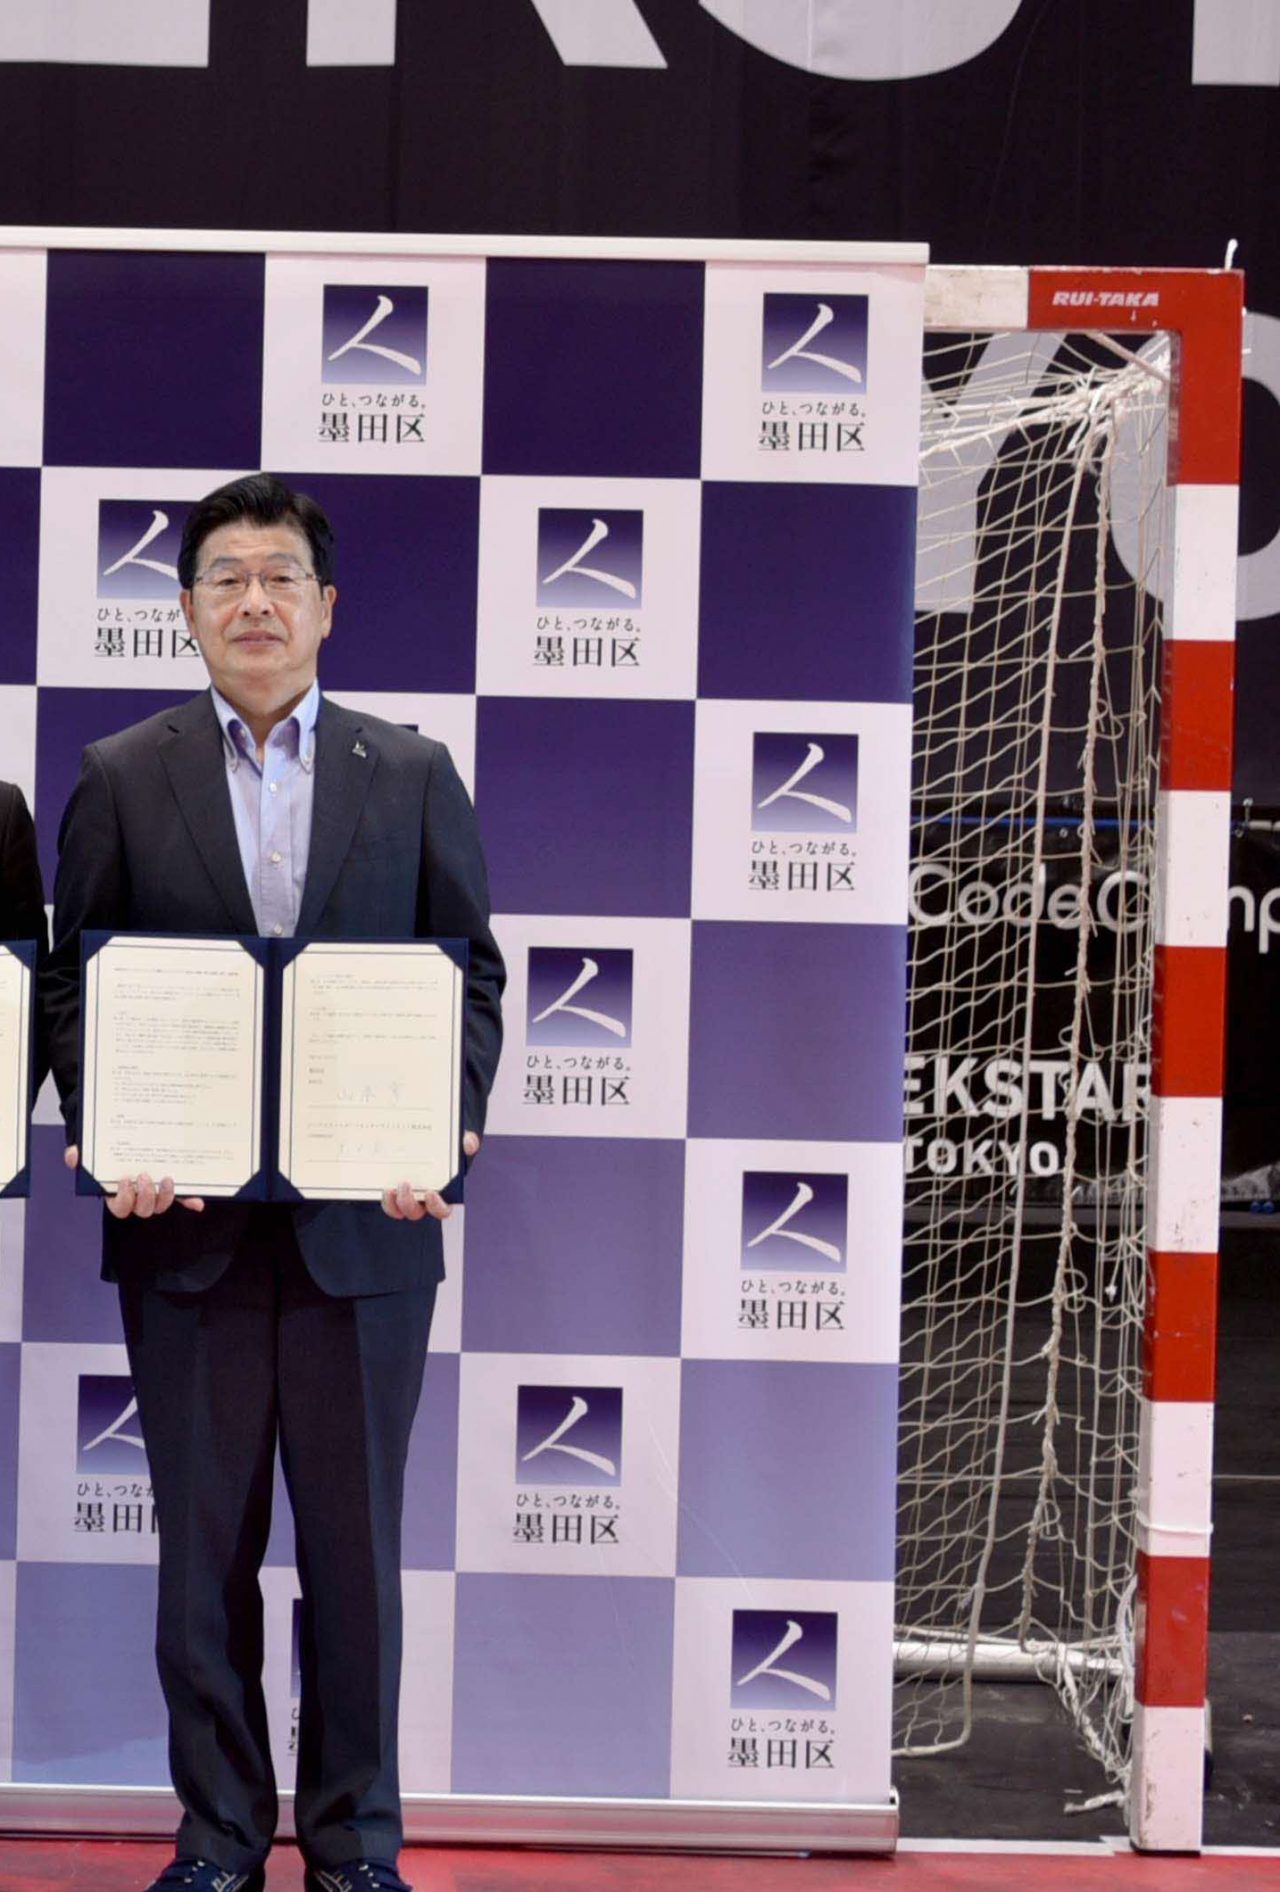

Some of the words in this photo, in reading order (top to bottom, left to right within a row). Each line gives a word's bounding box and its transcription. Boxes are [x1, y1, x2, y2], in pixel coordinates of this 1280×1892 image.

[1052, 290, 1160, 307] RUI-TAKA
[319, 412, 425, 444] 墨田区
[759, 421, 865, 452] 墨田区
[534, 636, 639, 668] 墨田区
[749, 860, 855, 892] 墨田区
[524, 1074, 629, 1106] 墨田区
[739, 1299, 844, 1331] 墨田区
[73, 1502, 159, 1534] 墨田
[513, 1512, 619, 1545] 墨田区
[728, 1737, 834, 1770] 墨田区
